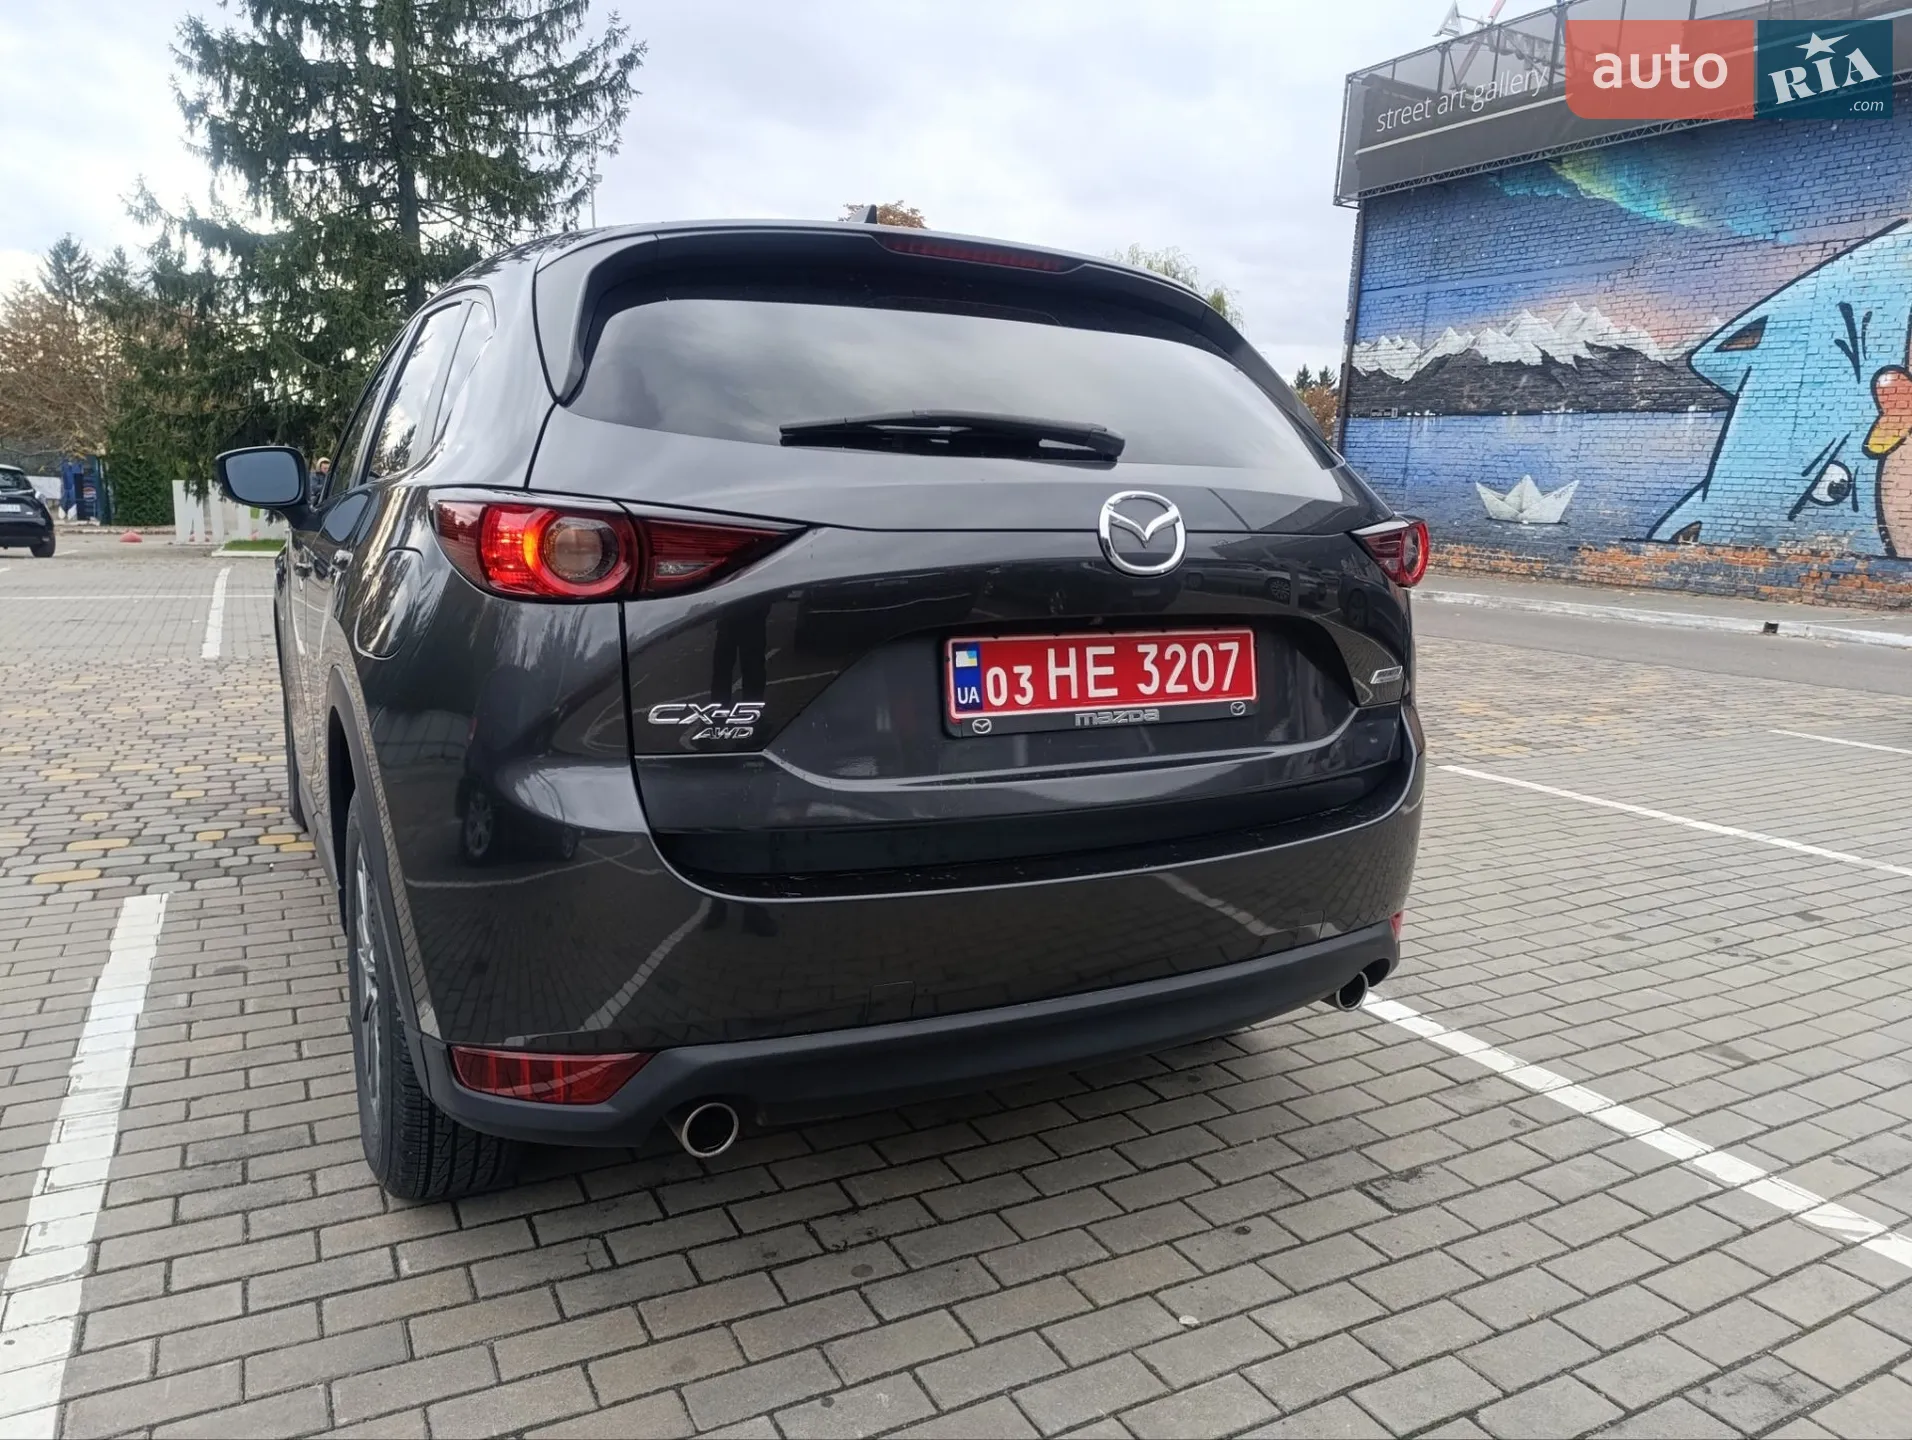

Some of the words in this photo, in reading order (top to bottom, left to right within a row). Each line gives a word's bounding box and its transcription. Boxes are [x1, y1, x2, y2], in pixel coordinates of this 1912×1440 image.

[1375, 97, 1432, 133] street
[1437, 83, 1467, 119] art
[1470, 65, 1549, 114] gallery
[985, 664, 1035, 707] 03
[1047, 645, 1119, 701] HE
[1136, 641, 1240, 696] 3207
[957, 686, 981, 705] UA
[647, 702, 766, 725] CX-5
[691, 726, 754, 741] AWD
